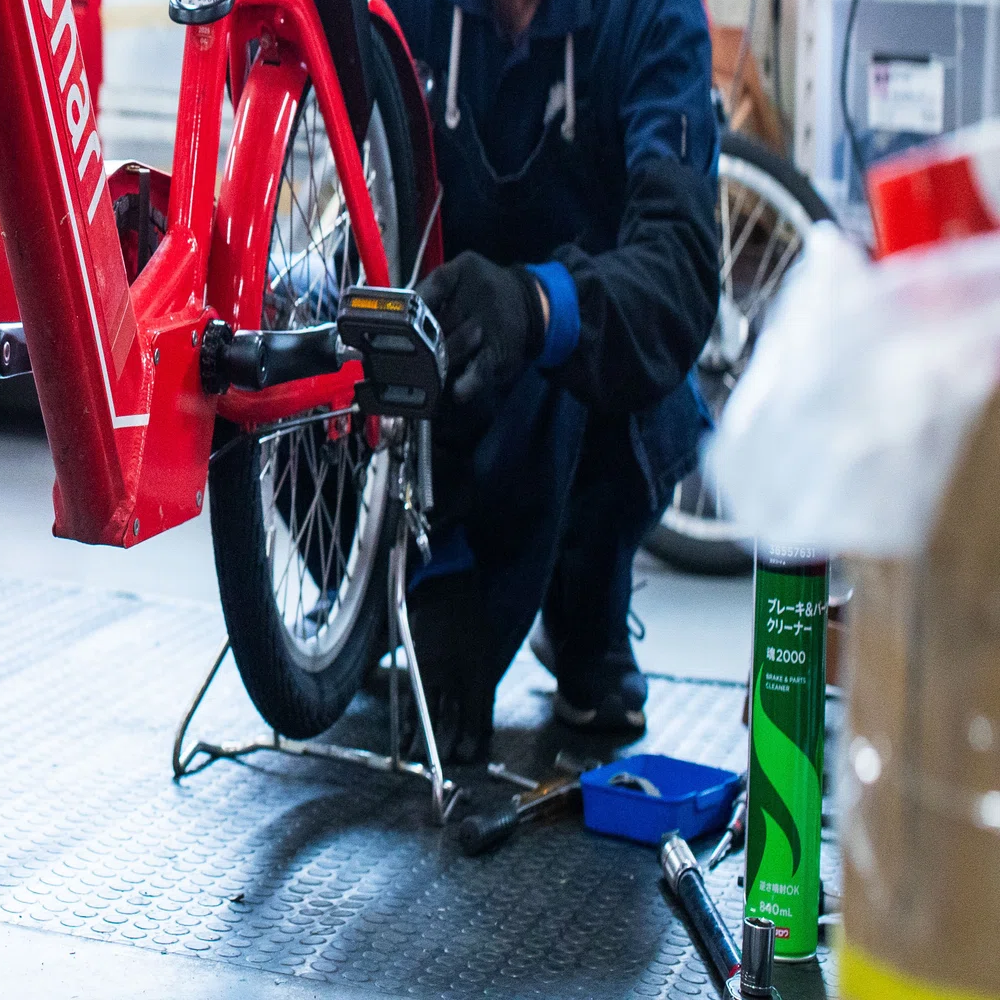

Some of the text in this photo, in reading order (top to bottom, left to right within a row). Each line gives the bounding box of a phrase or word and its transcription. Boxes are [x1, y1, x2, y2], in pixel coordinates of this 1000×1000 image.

[766, 617, 812, 636] クリーナー
[765, 673, 783, 682] BRAKE
[789, 676, 806, 684] PARTS
[765, 682, 790, 692] CLEANER
